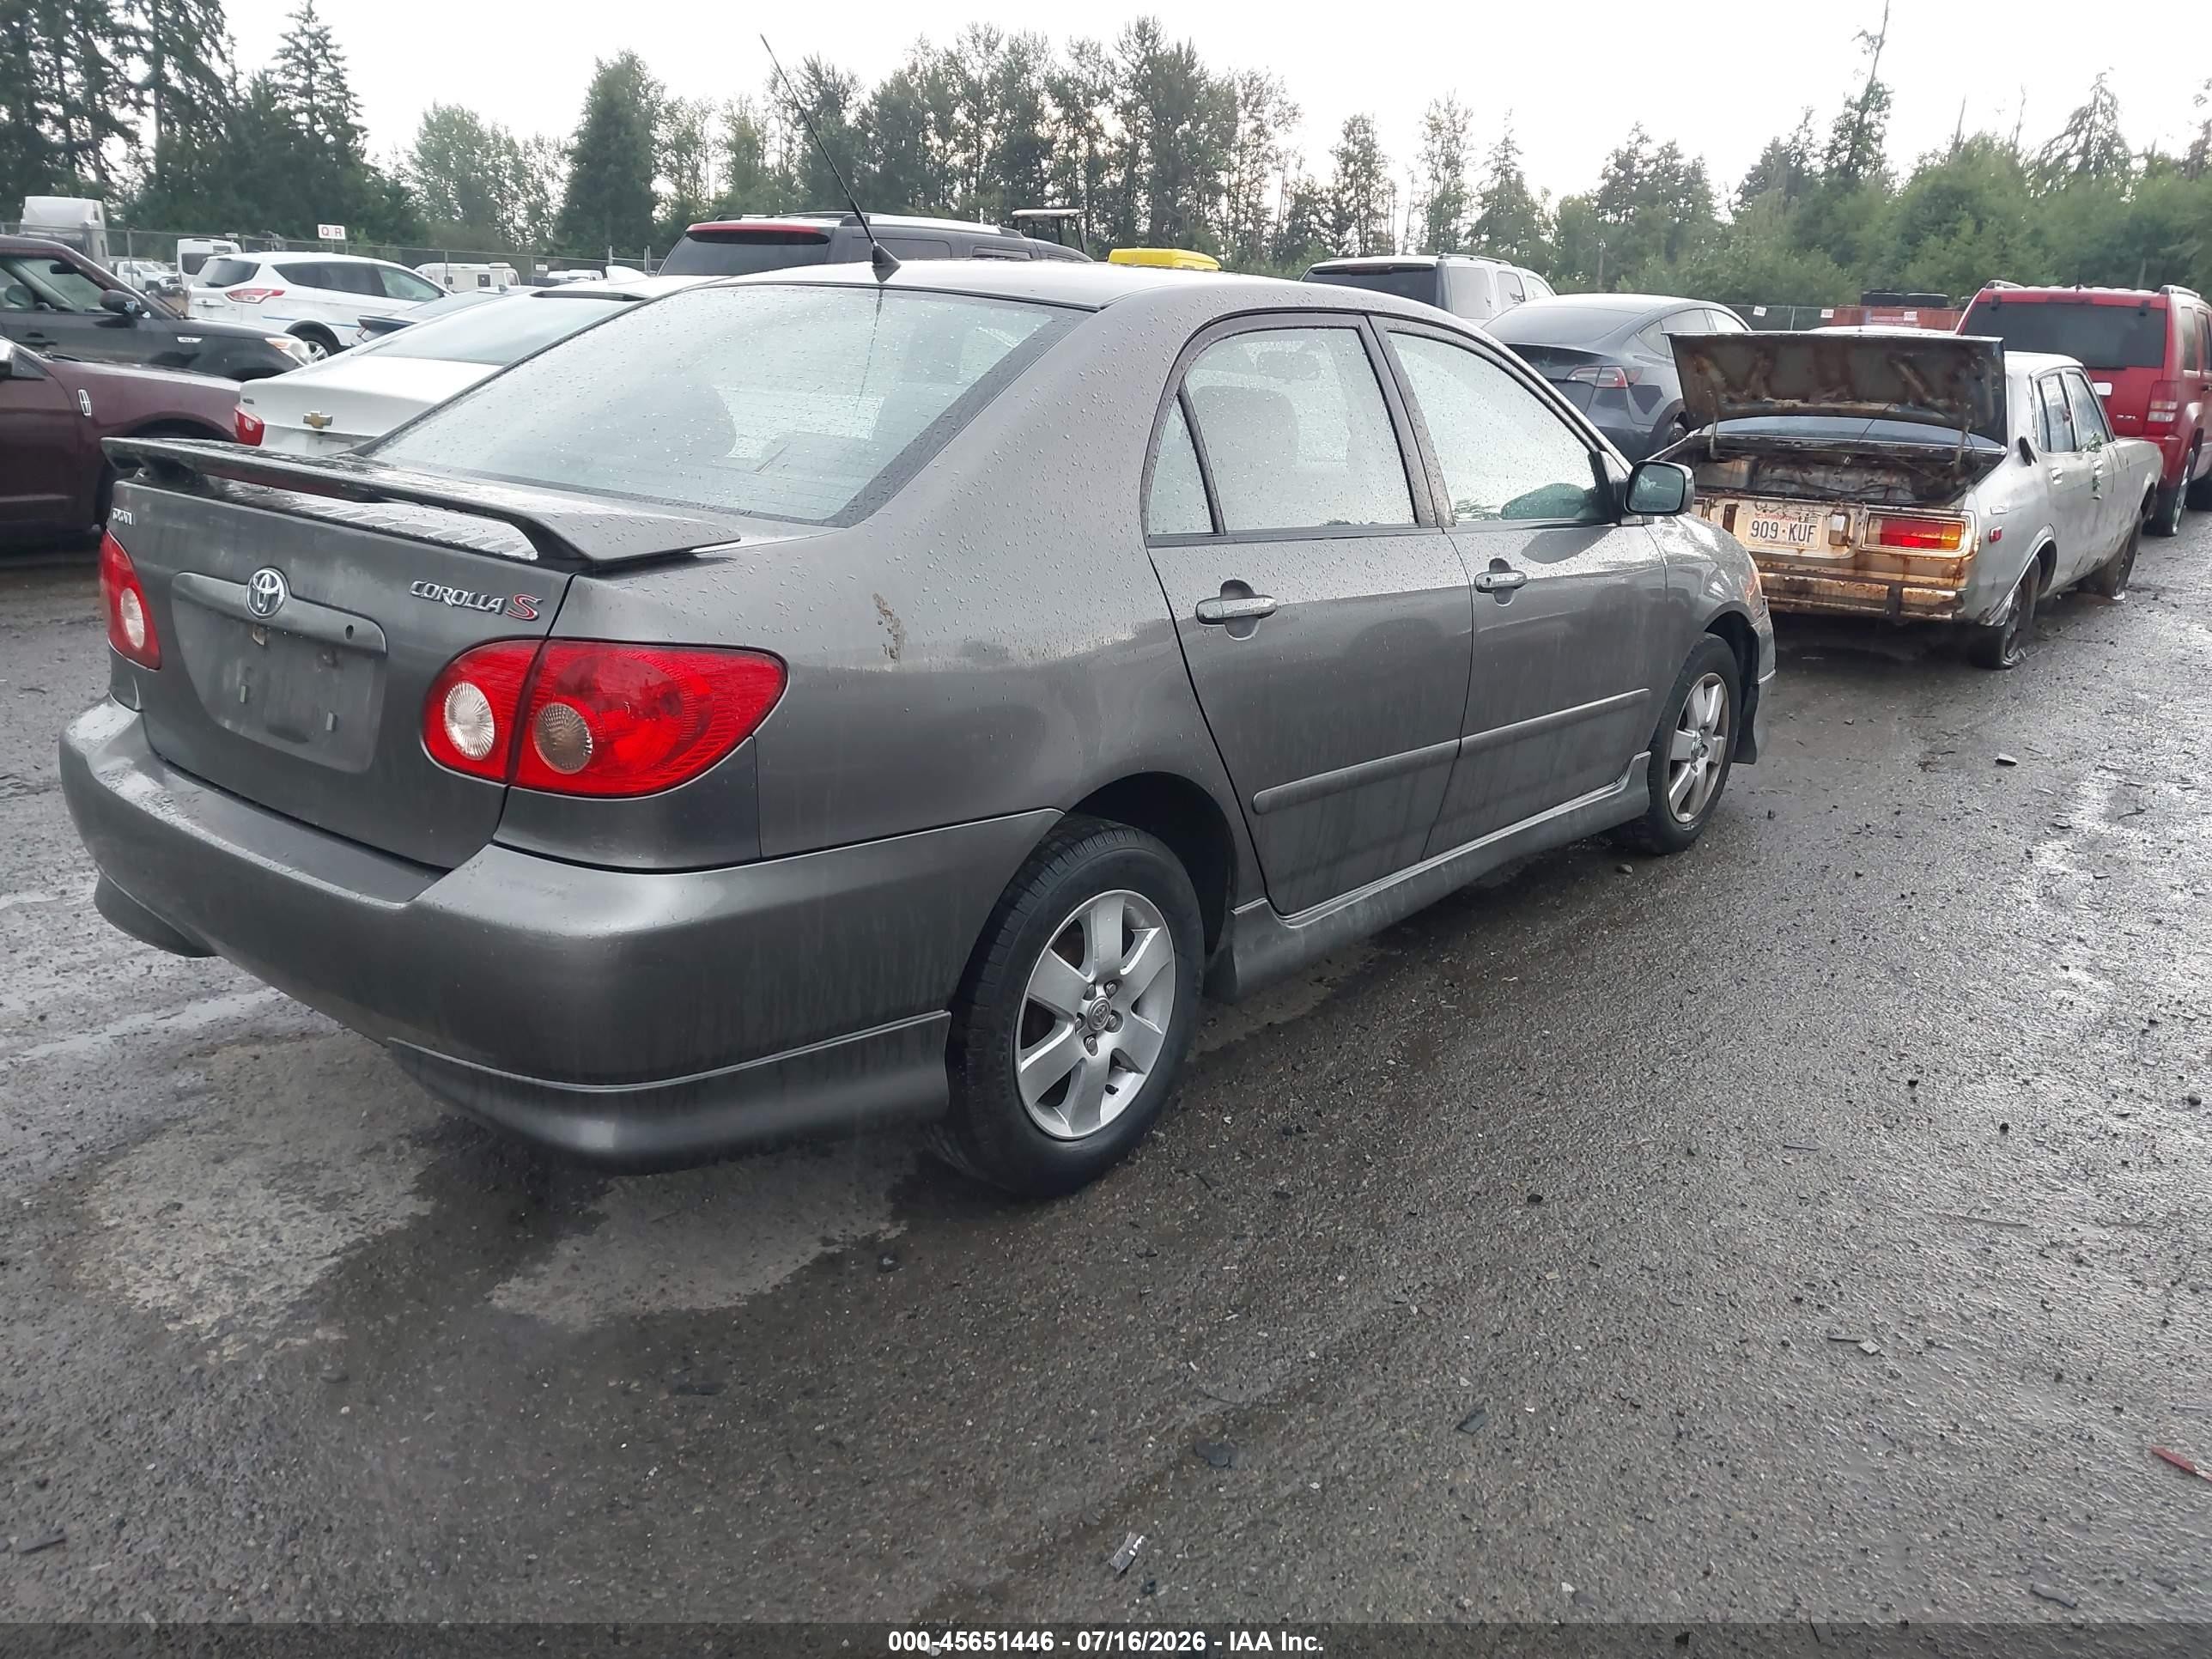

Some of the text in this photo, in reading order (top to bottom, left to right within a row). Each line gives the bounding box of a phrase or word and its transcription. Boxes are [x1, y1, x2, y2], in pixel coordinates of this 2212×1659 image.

[321, 226, 342, 237] Q R
[410, 580, 543, 621] COROLLA S
